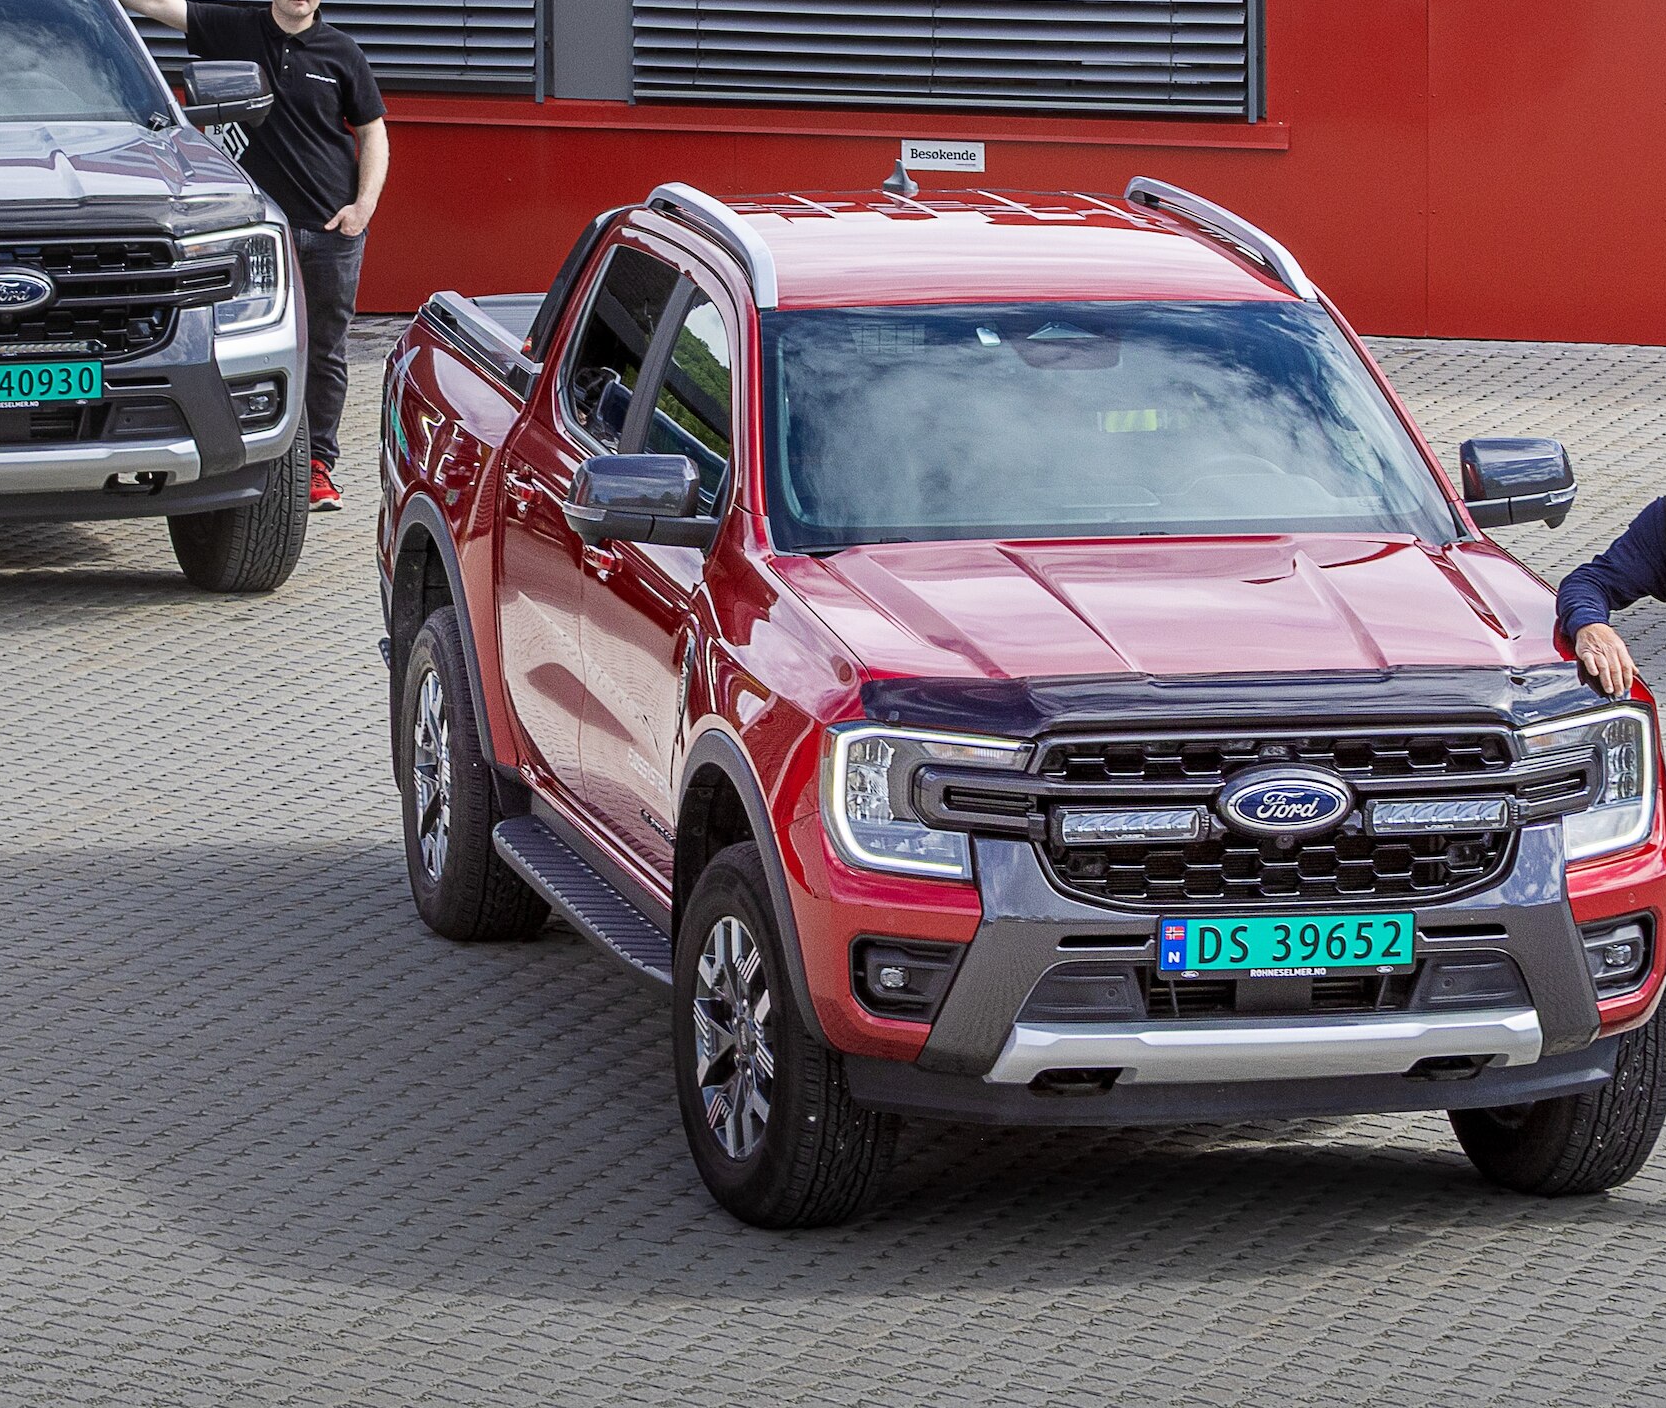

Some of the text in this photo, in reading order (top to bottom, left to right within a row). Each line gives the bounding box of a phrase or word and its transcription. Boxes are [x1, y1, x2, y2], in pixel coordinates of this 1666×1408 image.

[910, 148, 976, 161] Besøkende
[1256, 790, 1321, 819] Ford
[1198, 919, 1402, 964] DS 39652
[1167, 950, 1181, 964] N
